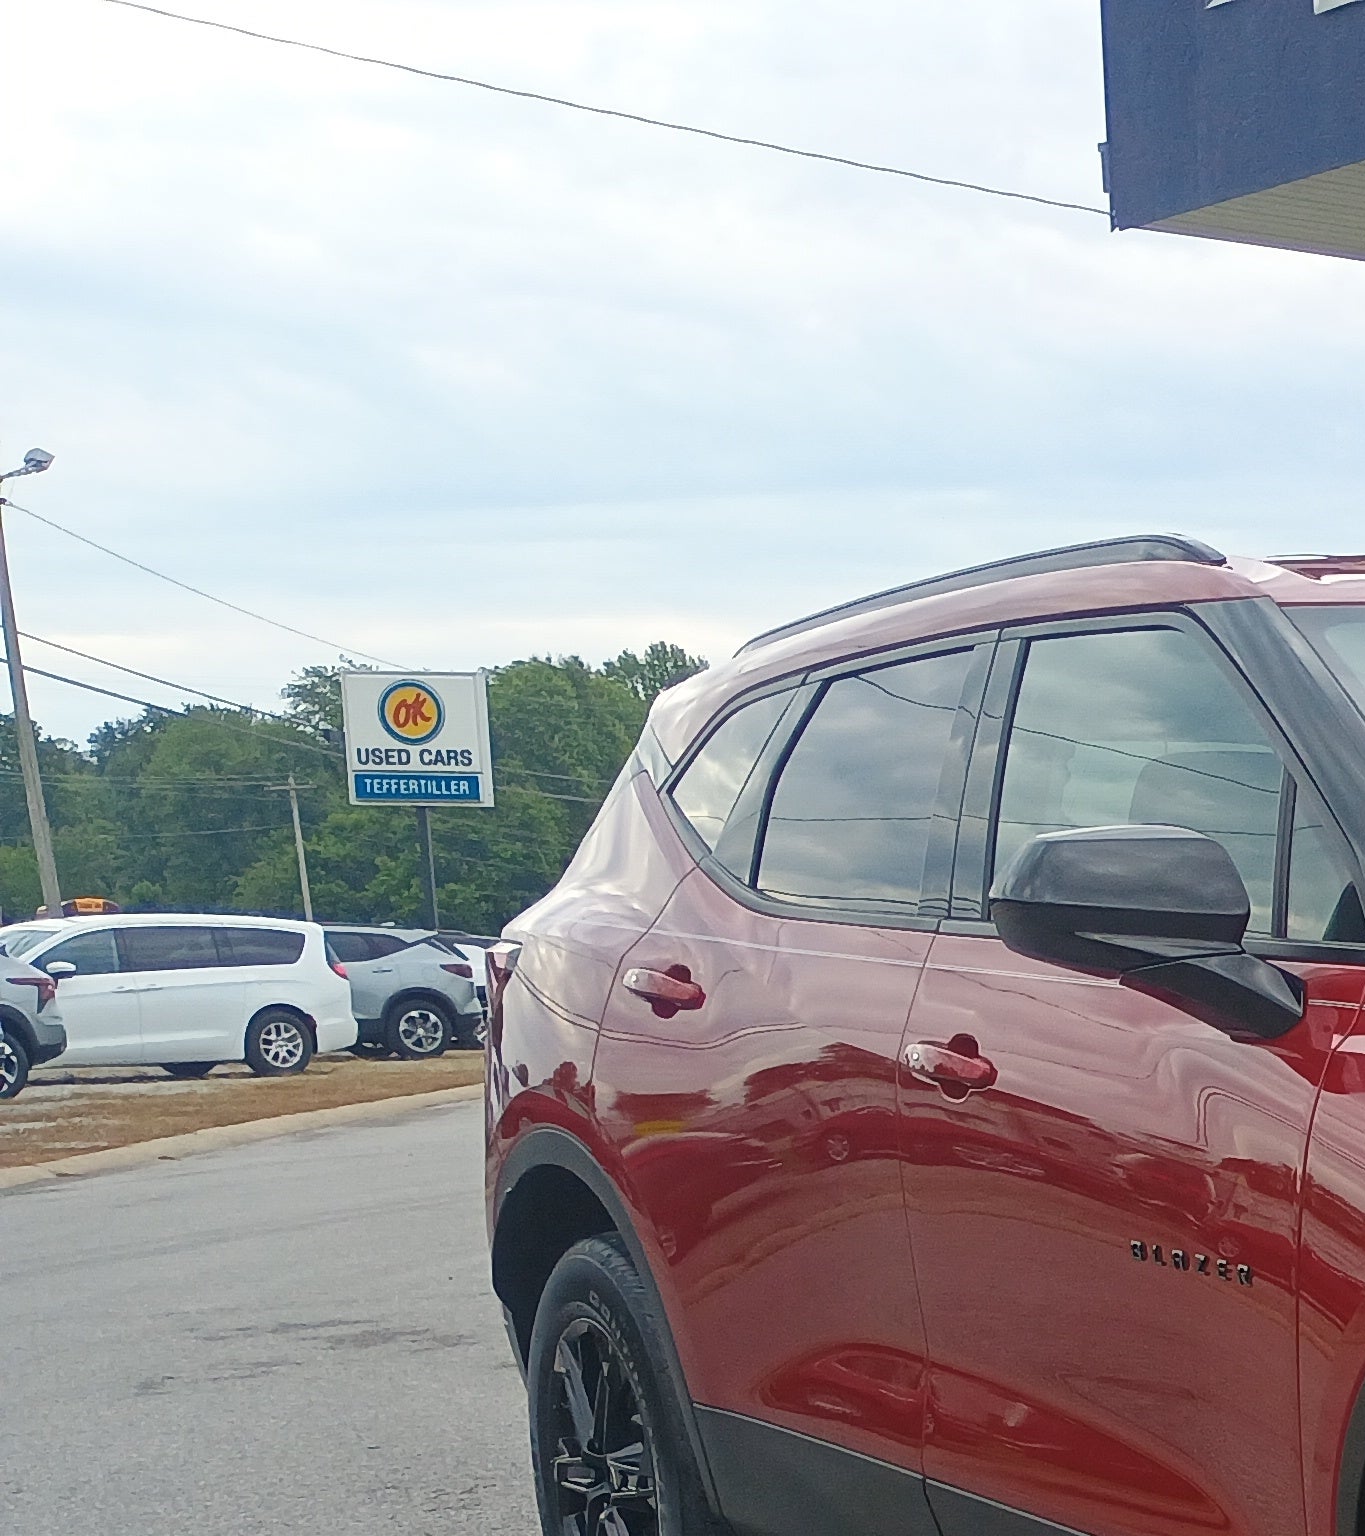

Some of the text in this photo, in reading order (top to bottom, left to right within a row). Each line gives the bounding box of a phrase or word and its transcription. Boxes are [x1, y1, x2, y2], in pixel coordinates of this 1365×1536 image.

[393, 692, 432, 728] OK
[356, 748, 473, 767] USED CARS
[363, 778, 470, 795] TEFFERTILLER
[1130, 1239, 1253, 1288] BLAZER
